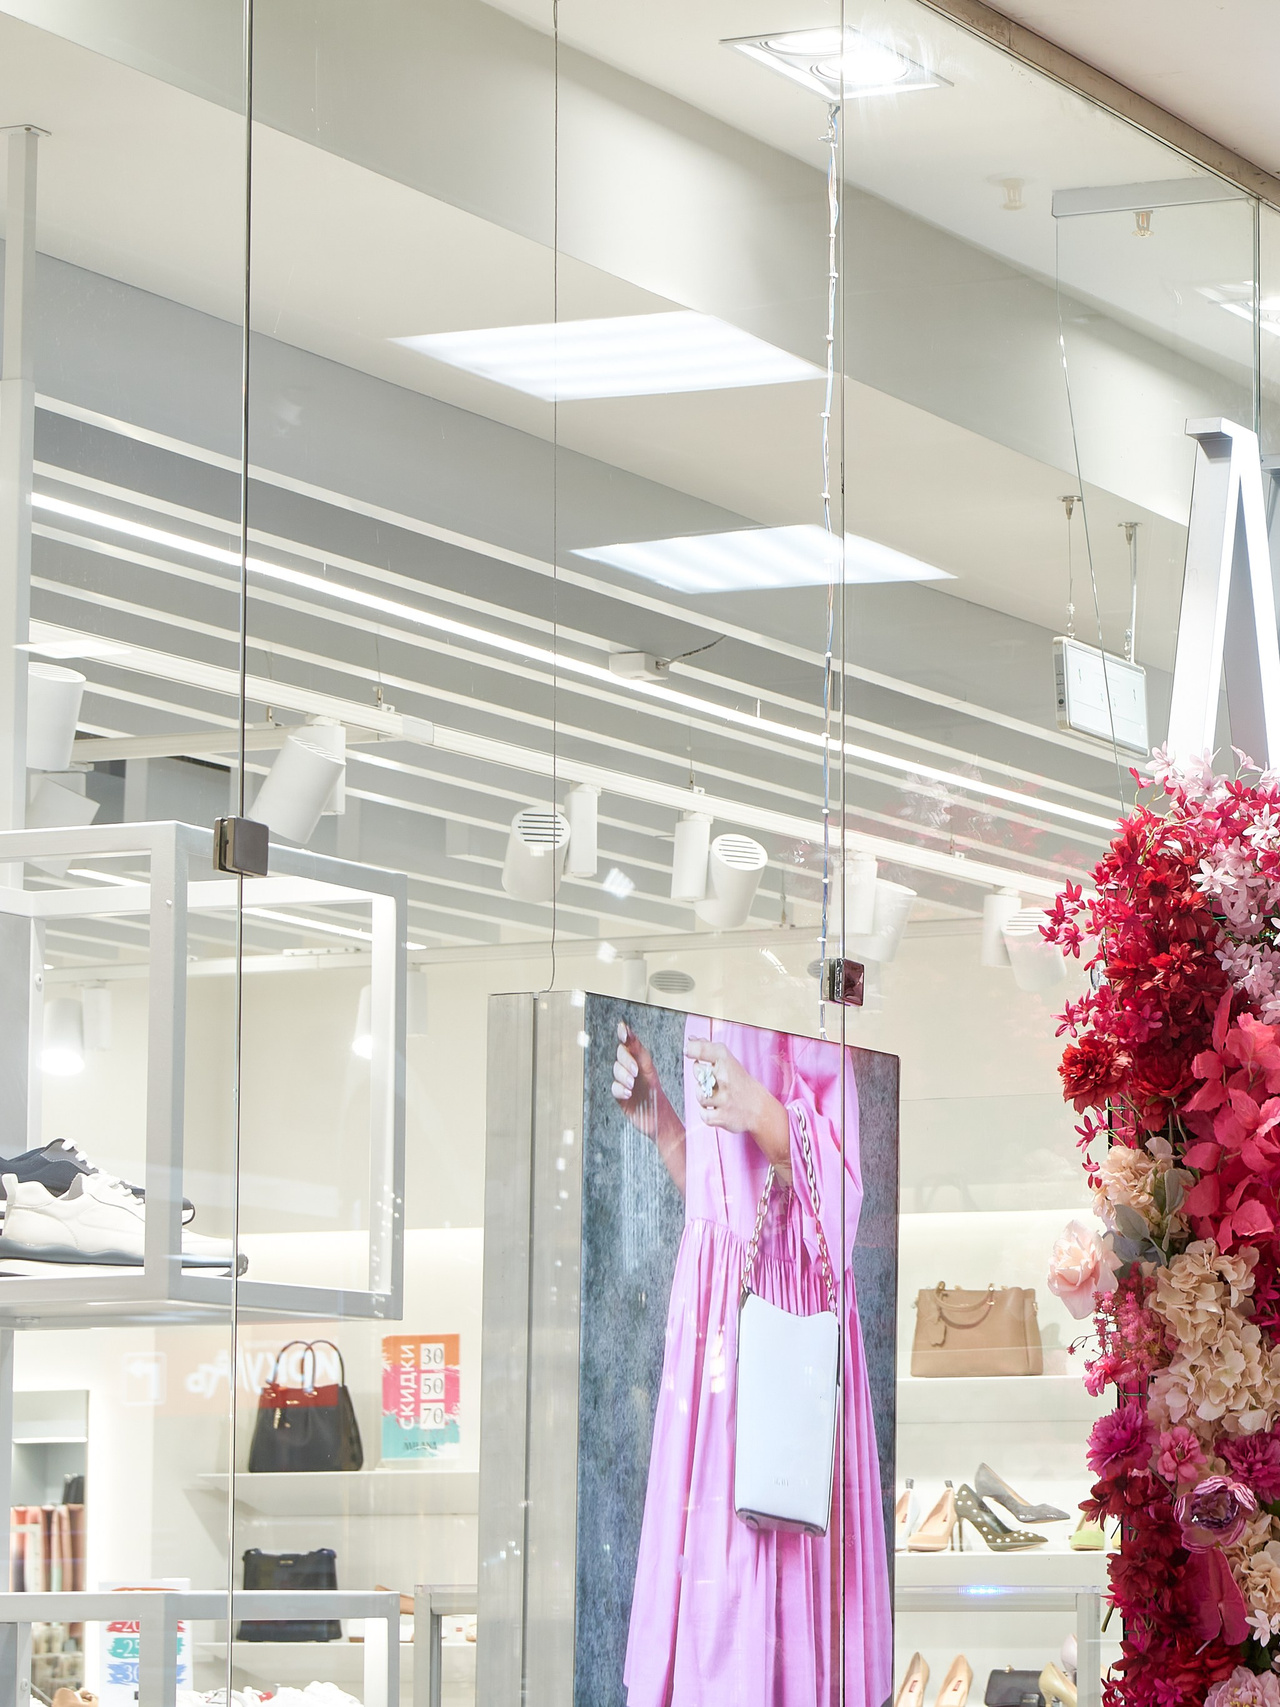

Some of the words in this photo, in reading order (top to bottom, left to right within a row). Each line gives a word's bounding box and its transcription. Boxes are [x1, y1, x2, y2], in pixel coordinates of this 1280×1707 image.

[422, 1347, 444, 1365] 30
[400, 1344, 418, 1430] СКИДКИ
[422, 1377, 444, 1395] 50
[422, 1407, 444, 1425] 70
